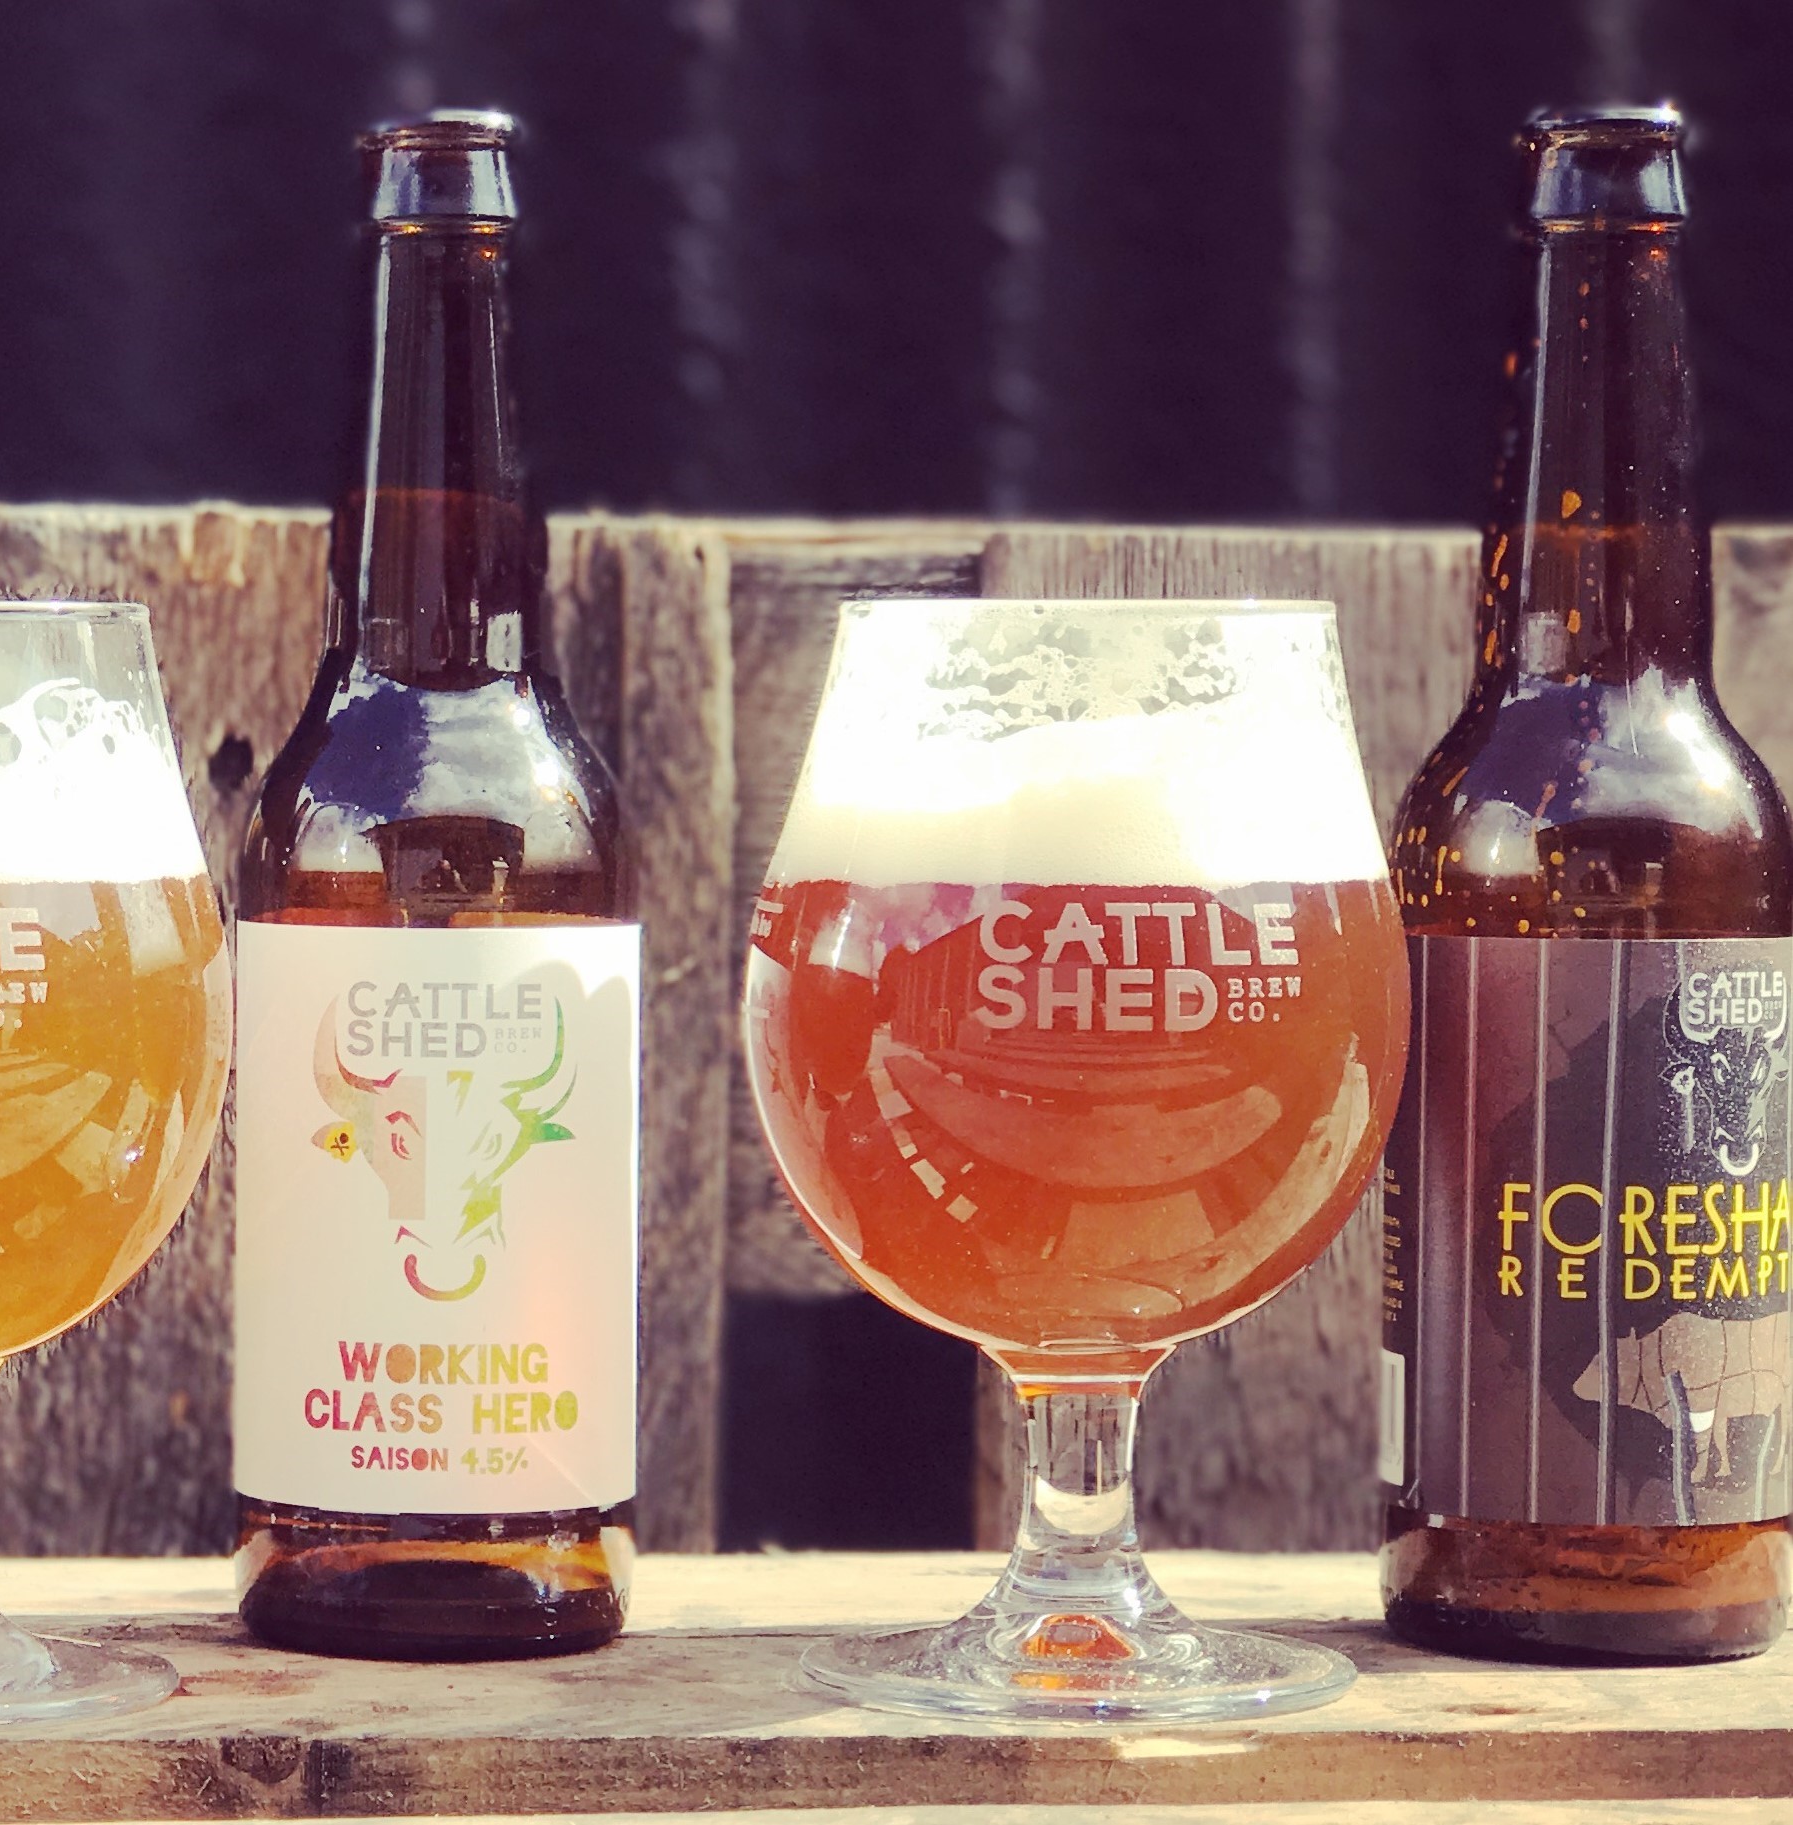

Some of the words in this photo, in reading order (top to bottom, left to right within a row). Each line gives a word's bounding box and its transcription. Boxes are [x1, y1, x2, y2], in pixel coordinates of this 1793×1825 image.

[979, 900, 1299, 966] CATTLE
[347, 981, 542, 1020] CATTLE
[975, 964, 1219, 1032] SHED
[1227, 977, 1301, 998] BREW
[1688, 971, 1783, 998] CATTLE
[1227, 1001, 1282, 1022] CO.
[1687, 998, 1763, 1025] SHED
[346, 1020, 487, 1058] SHED
[338, 1340, 547, 1385] WORKING
[305, 1388, 443, 1434] CLASS
[472, 1390, 578, 1435] HERO
[351, 1445, 448, 1471] SAISON
[460, 1447, 528, 1475] 4.5%
